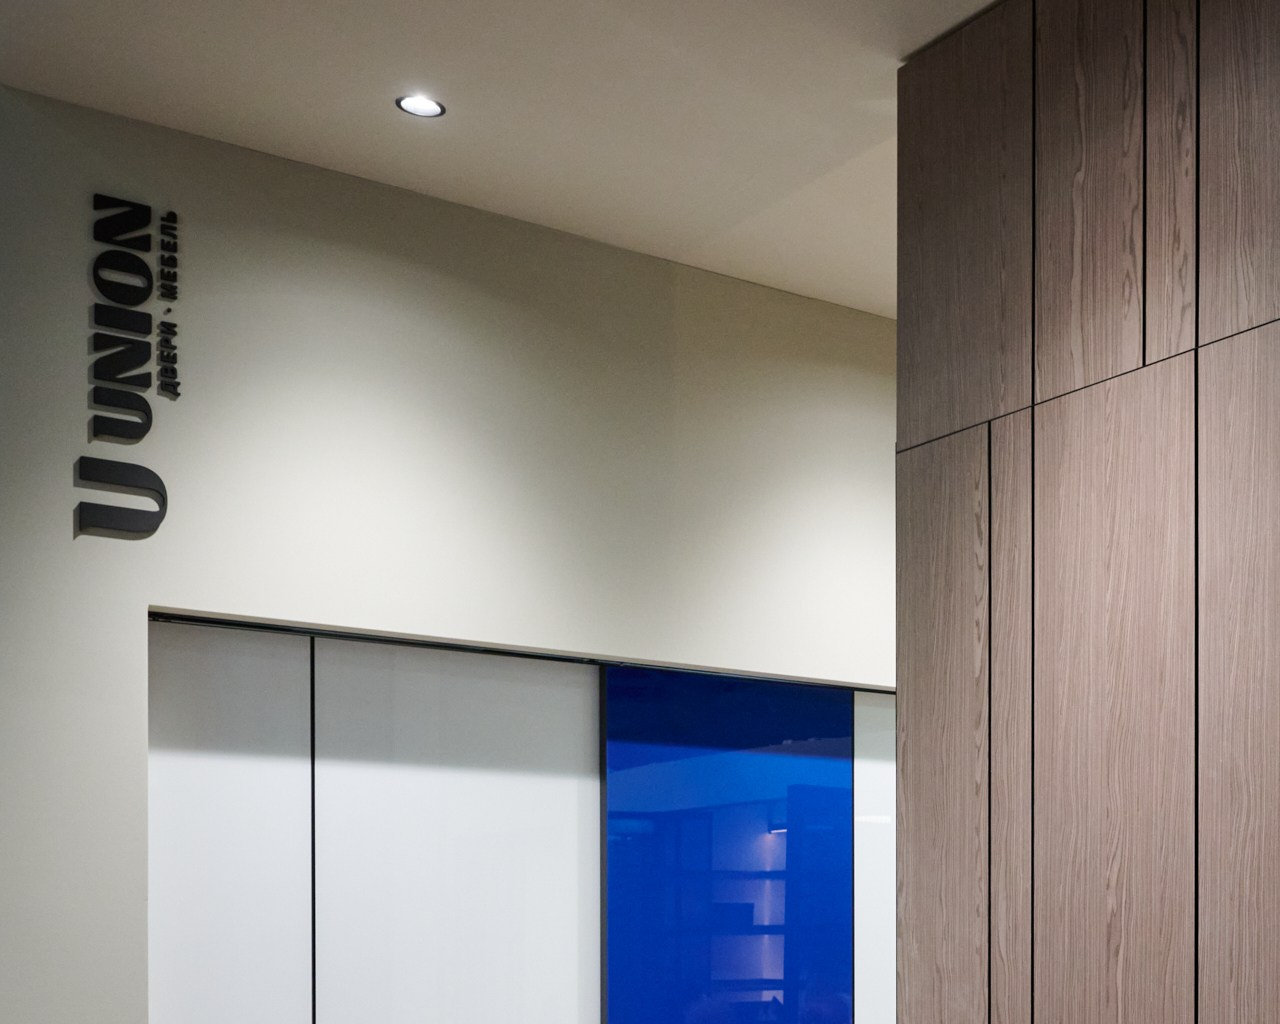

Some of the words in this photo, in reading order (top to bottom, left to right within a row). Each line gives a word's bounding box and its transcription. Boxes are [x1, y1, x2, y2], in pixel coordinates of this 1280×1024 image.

[158, 210, 178, 301] МЕБЕЛЬ
[91, 192, 154, 443] UNION
[159, 320, 181, 400] ДВЕРИ
